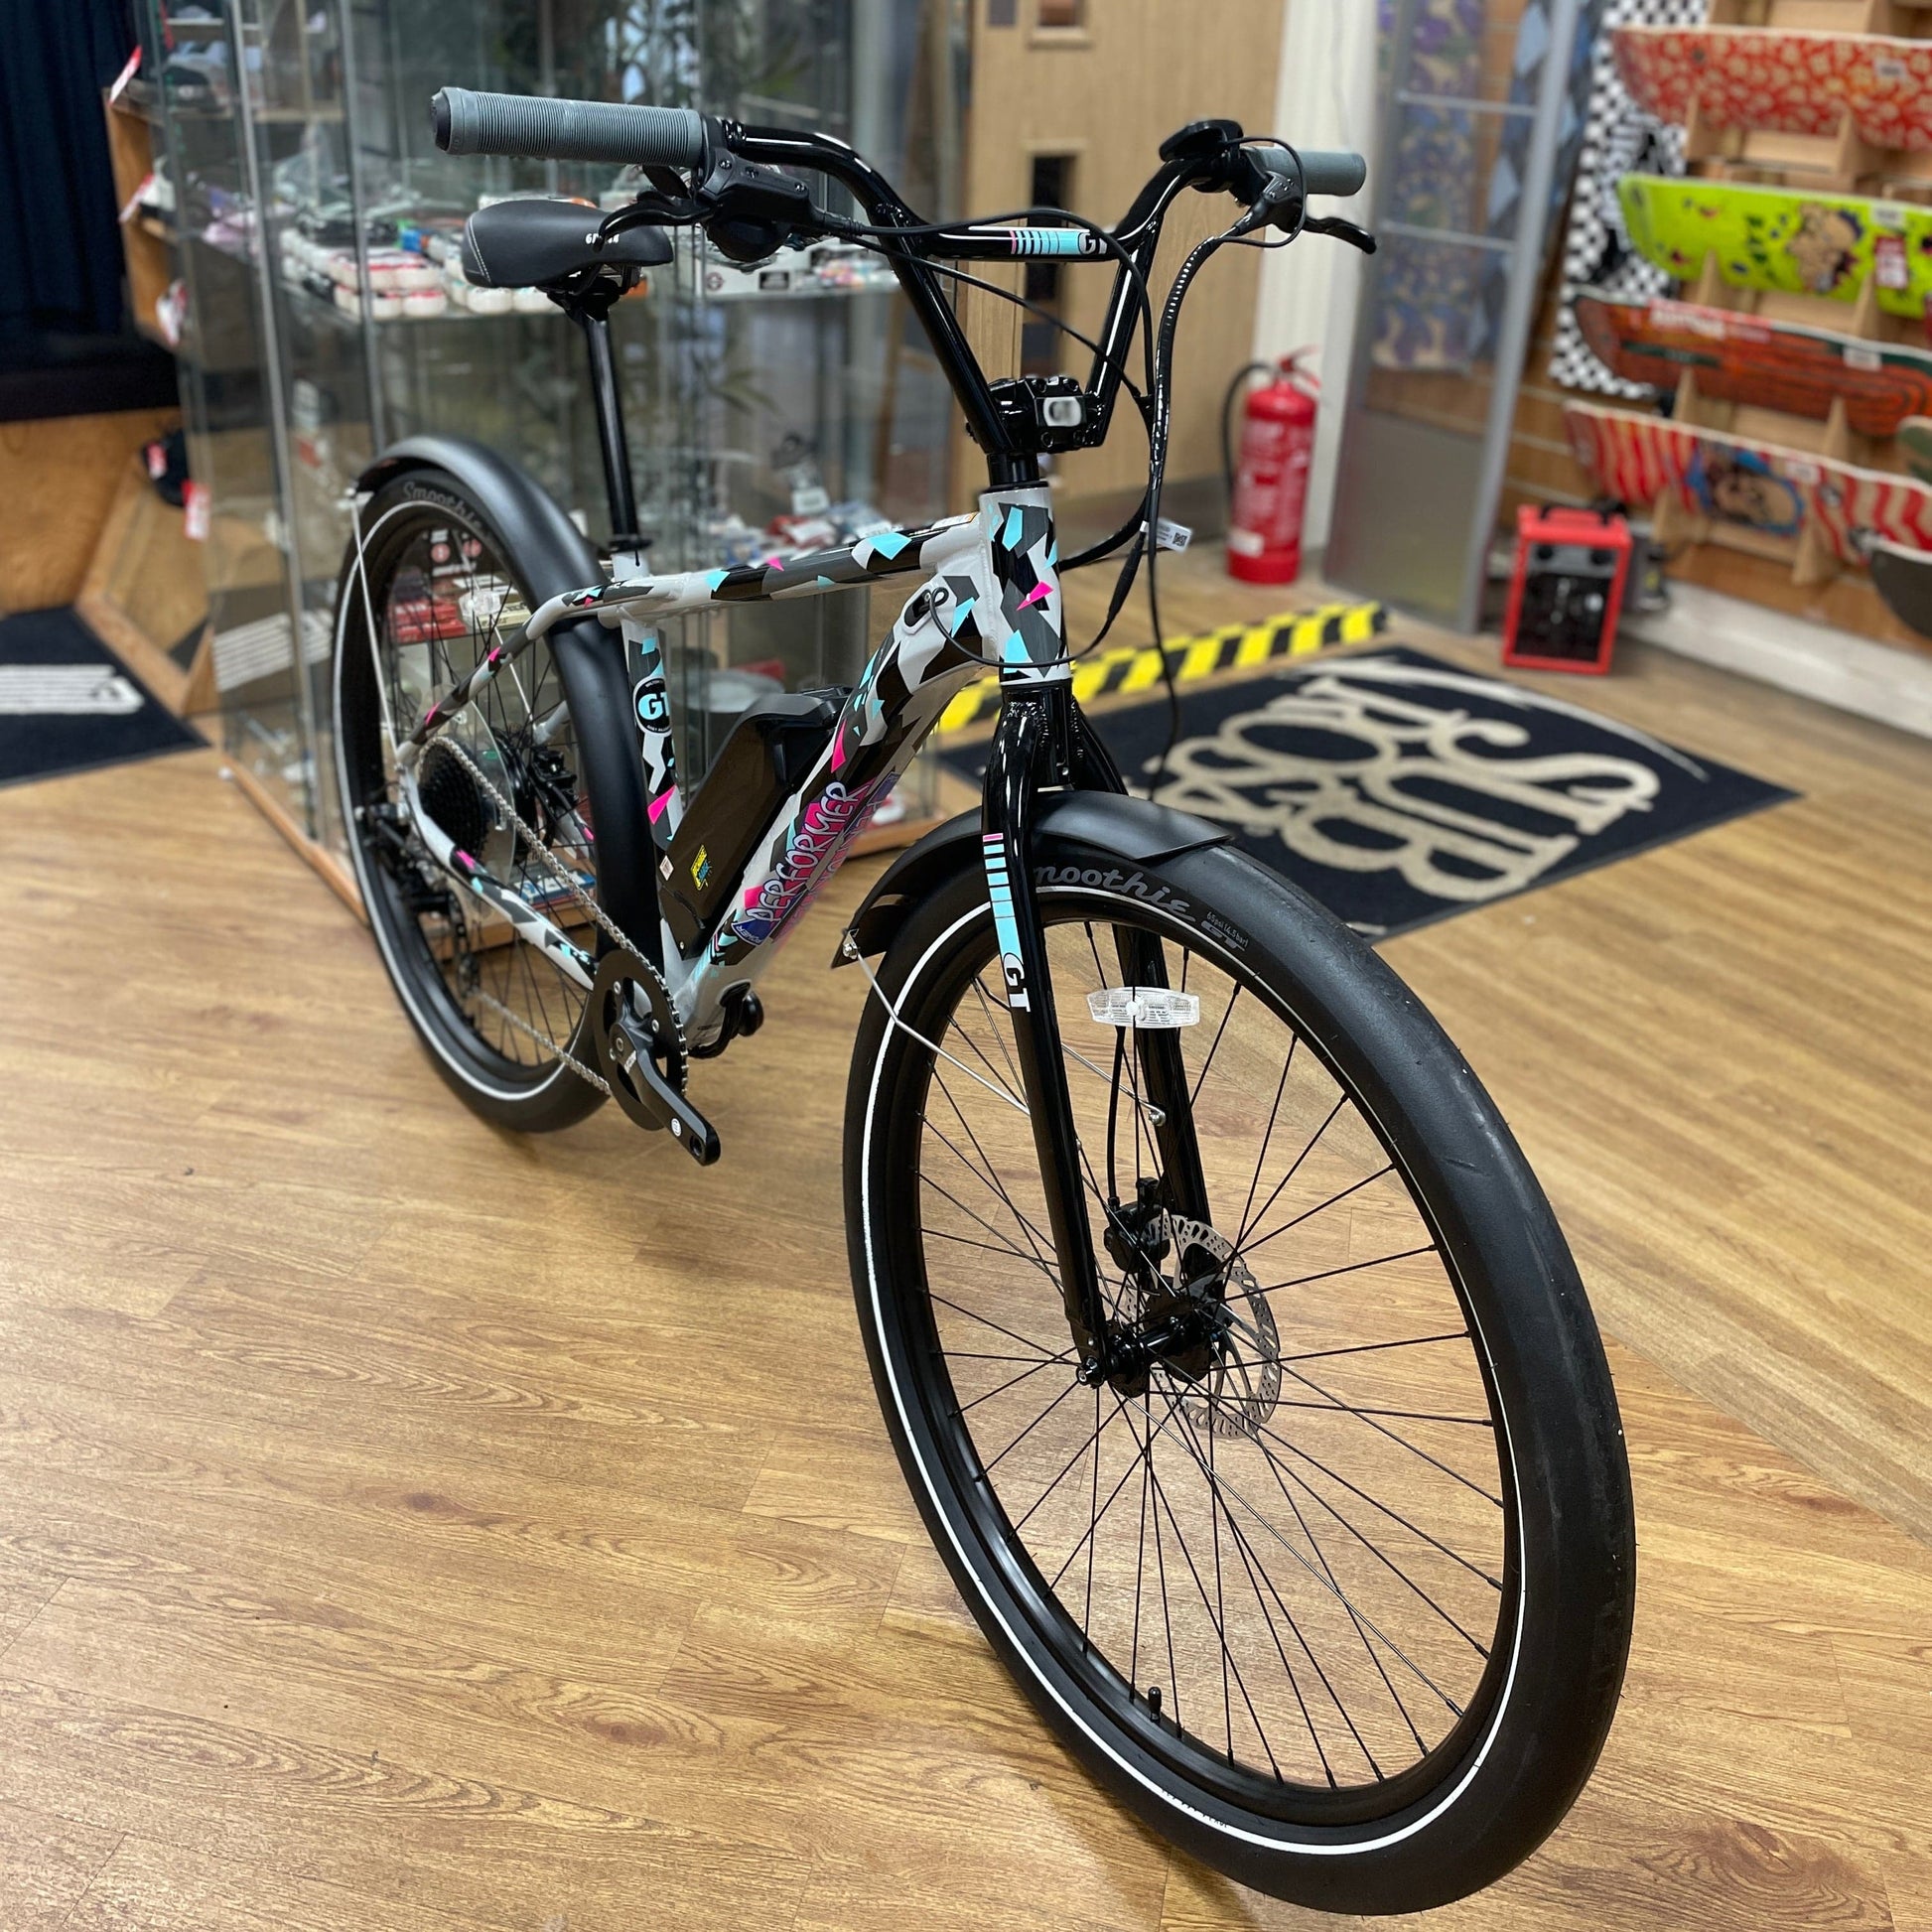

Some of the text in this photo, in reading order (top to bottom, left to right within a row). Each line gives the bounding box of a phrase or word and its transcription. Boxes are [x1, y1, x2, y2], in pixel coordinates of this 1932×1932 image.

[745, 780, 871, 923] PERFORMER
[1281, 717, 1660, 901] SUB
[1033, 865, 1197, 922] moothie
[1003, 953, 1032, 1013] GT
